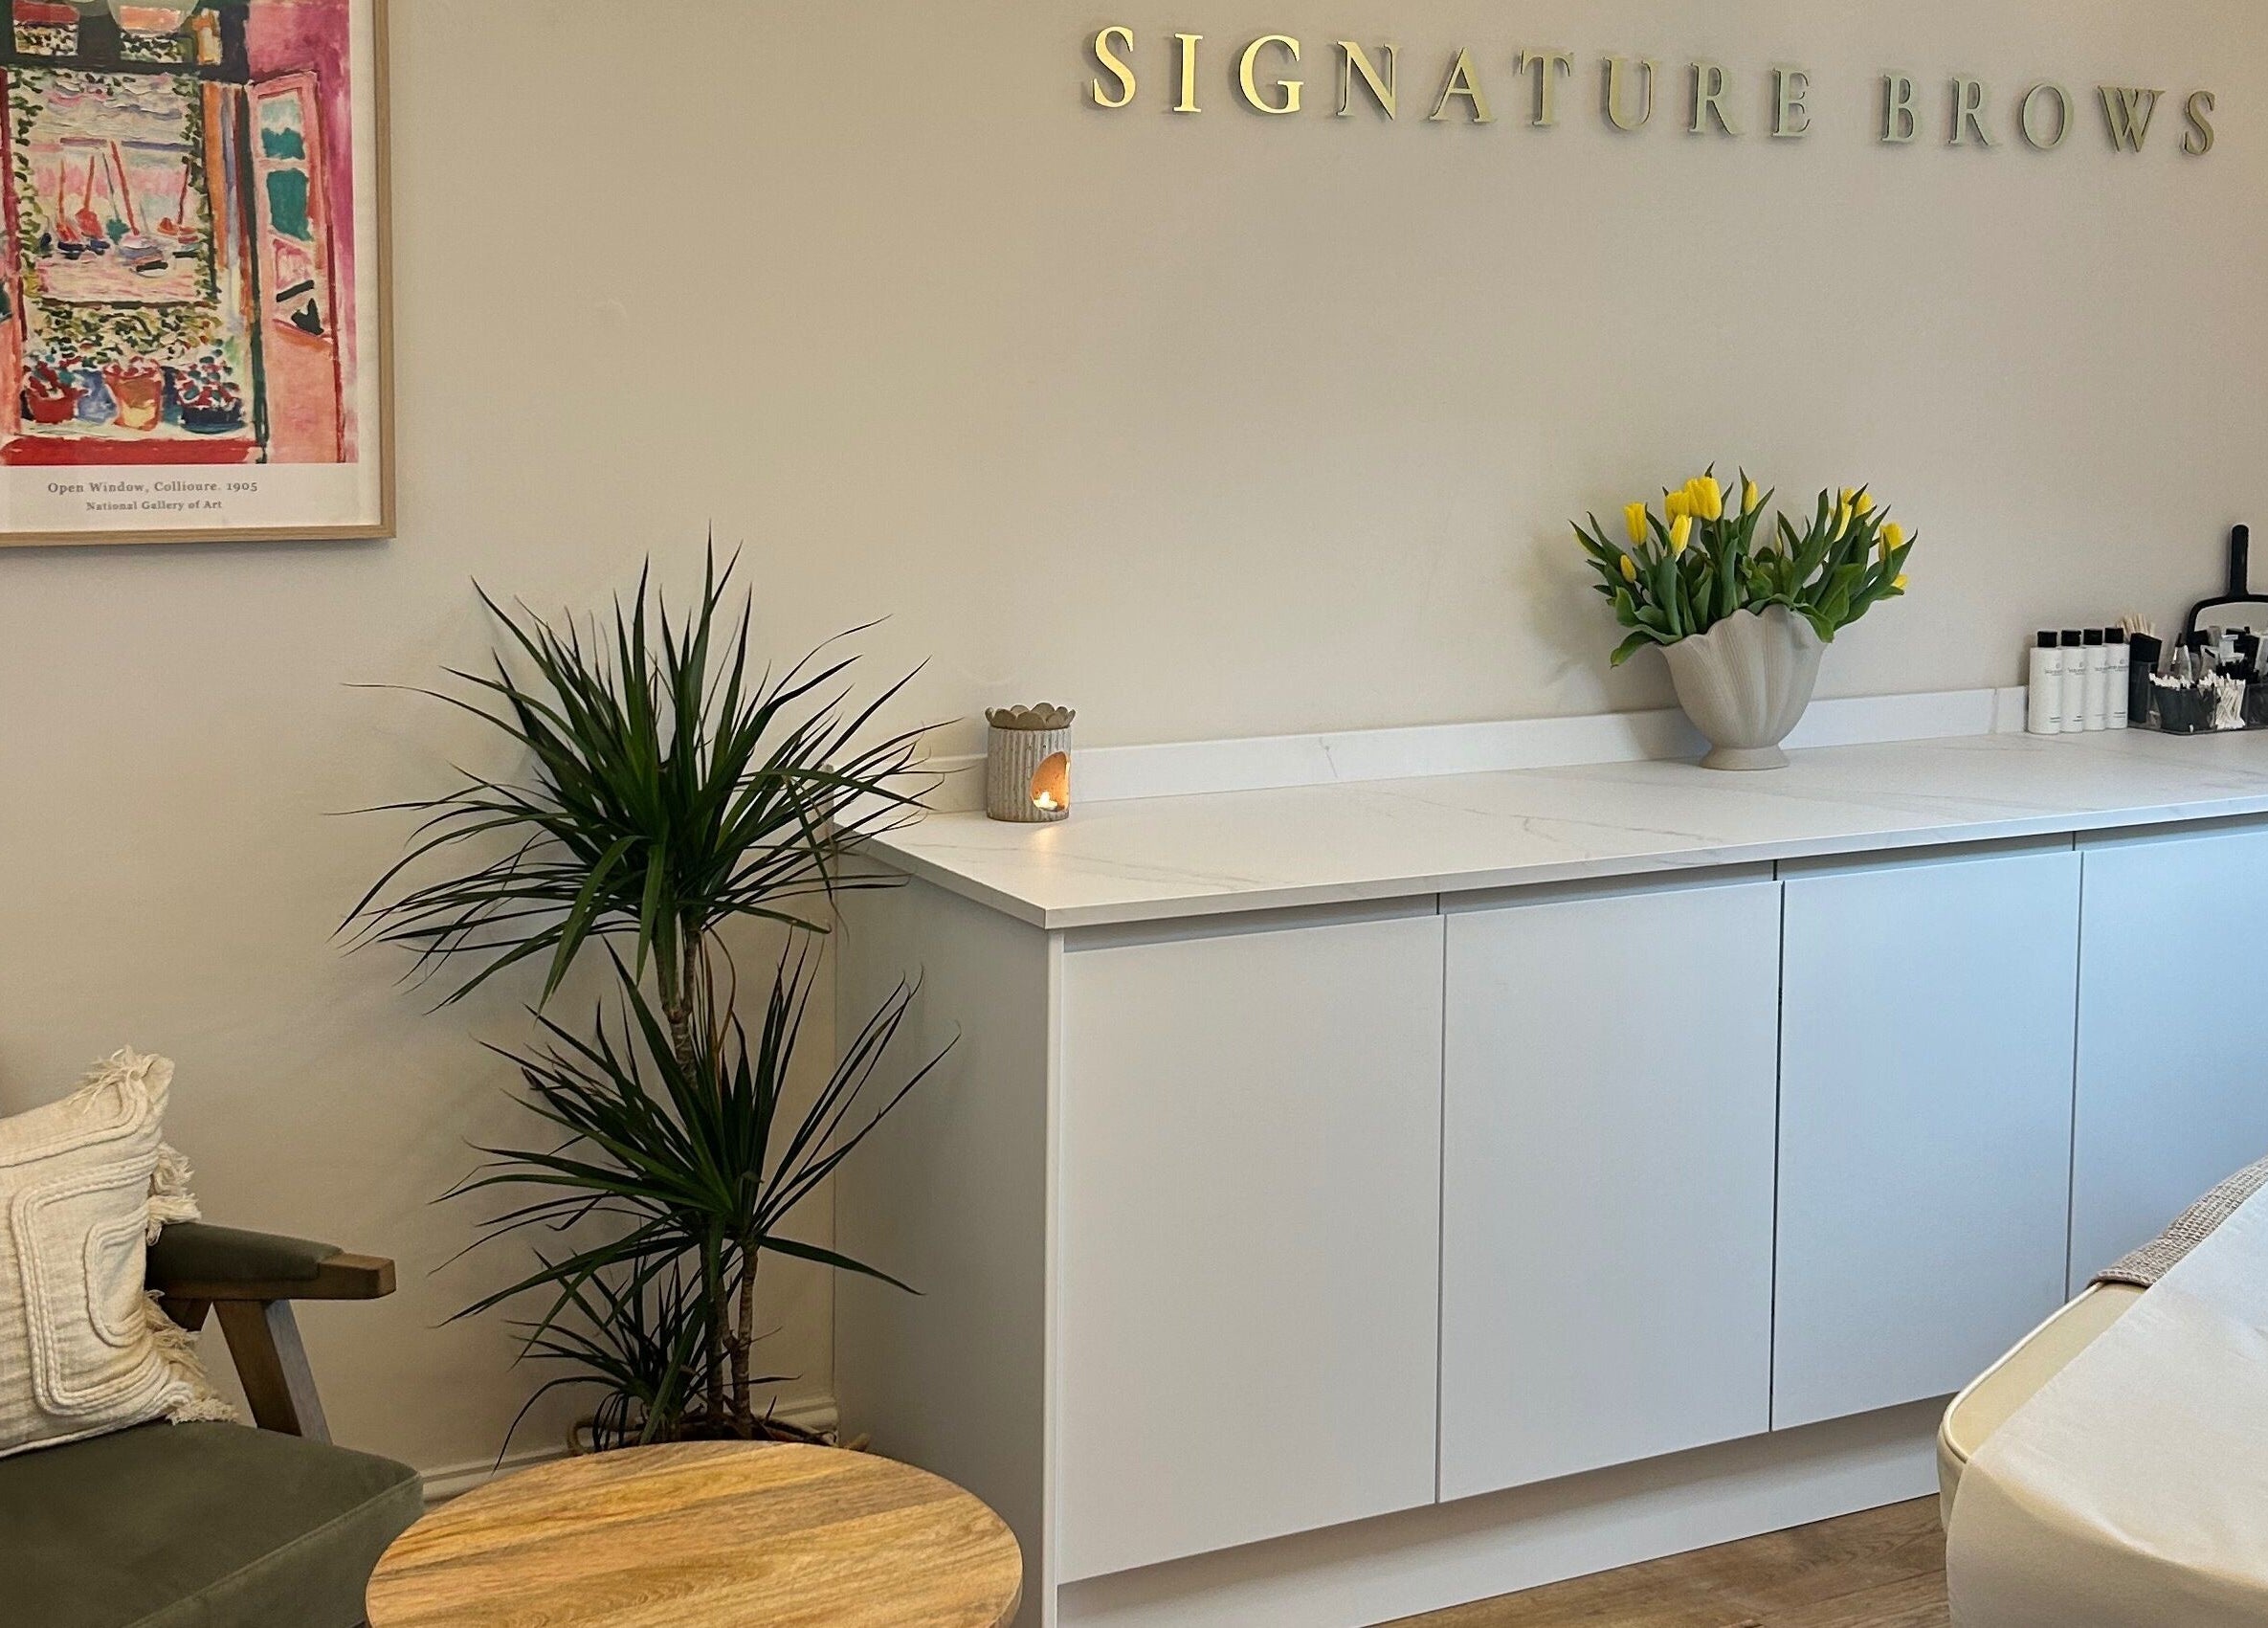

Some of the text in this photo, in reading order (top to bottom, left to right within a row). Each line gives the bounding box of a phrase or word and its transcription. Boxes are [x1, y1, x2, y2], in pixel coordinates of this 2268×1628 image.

[1092, 26, 2216, 156] SIGNATURE BROWS
[48, 482, 84, 496] Open
[89, 480, 149, 494] Window,
[227, 481, 258, 492] 1905
[86, 500, 223, 511] National Gallery of Art
